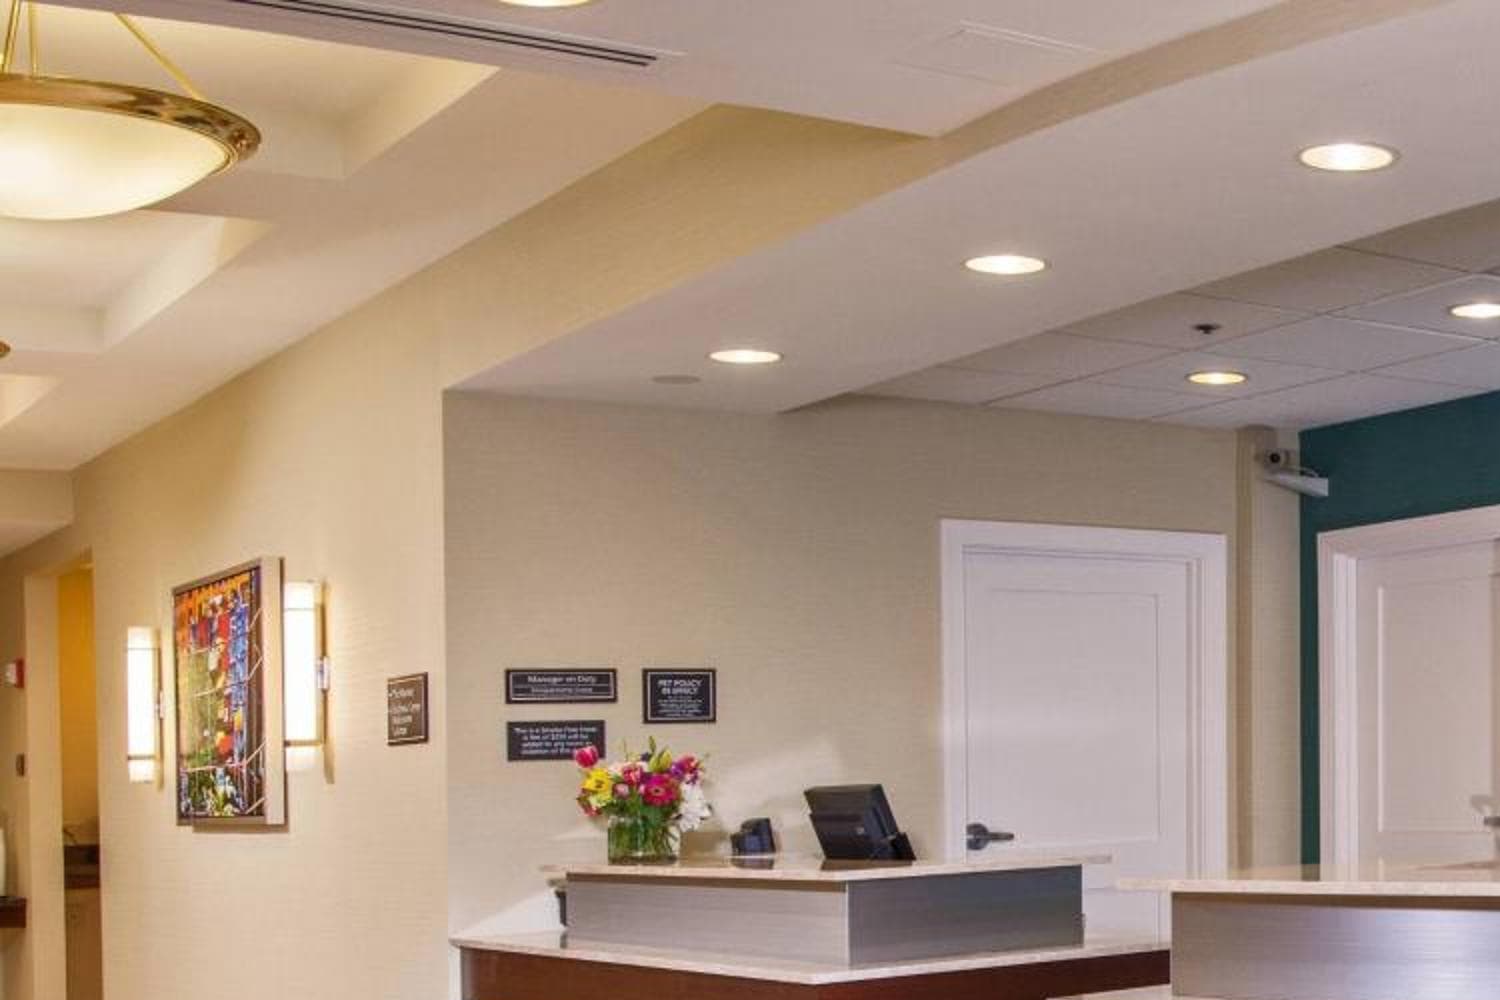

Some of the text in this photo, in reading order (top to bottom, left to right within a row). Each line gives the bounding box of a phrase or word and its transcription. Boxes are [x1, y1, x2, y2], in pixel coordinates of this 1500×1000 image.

[527, 675, 564, 685] Manager
[577, 675, 597, 684] Duty
[673, 679, 702, 688] POLICY
